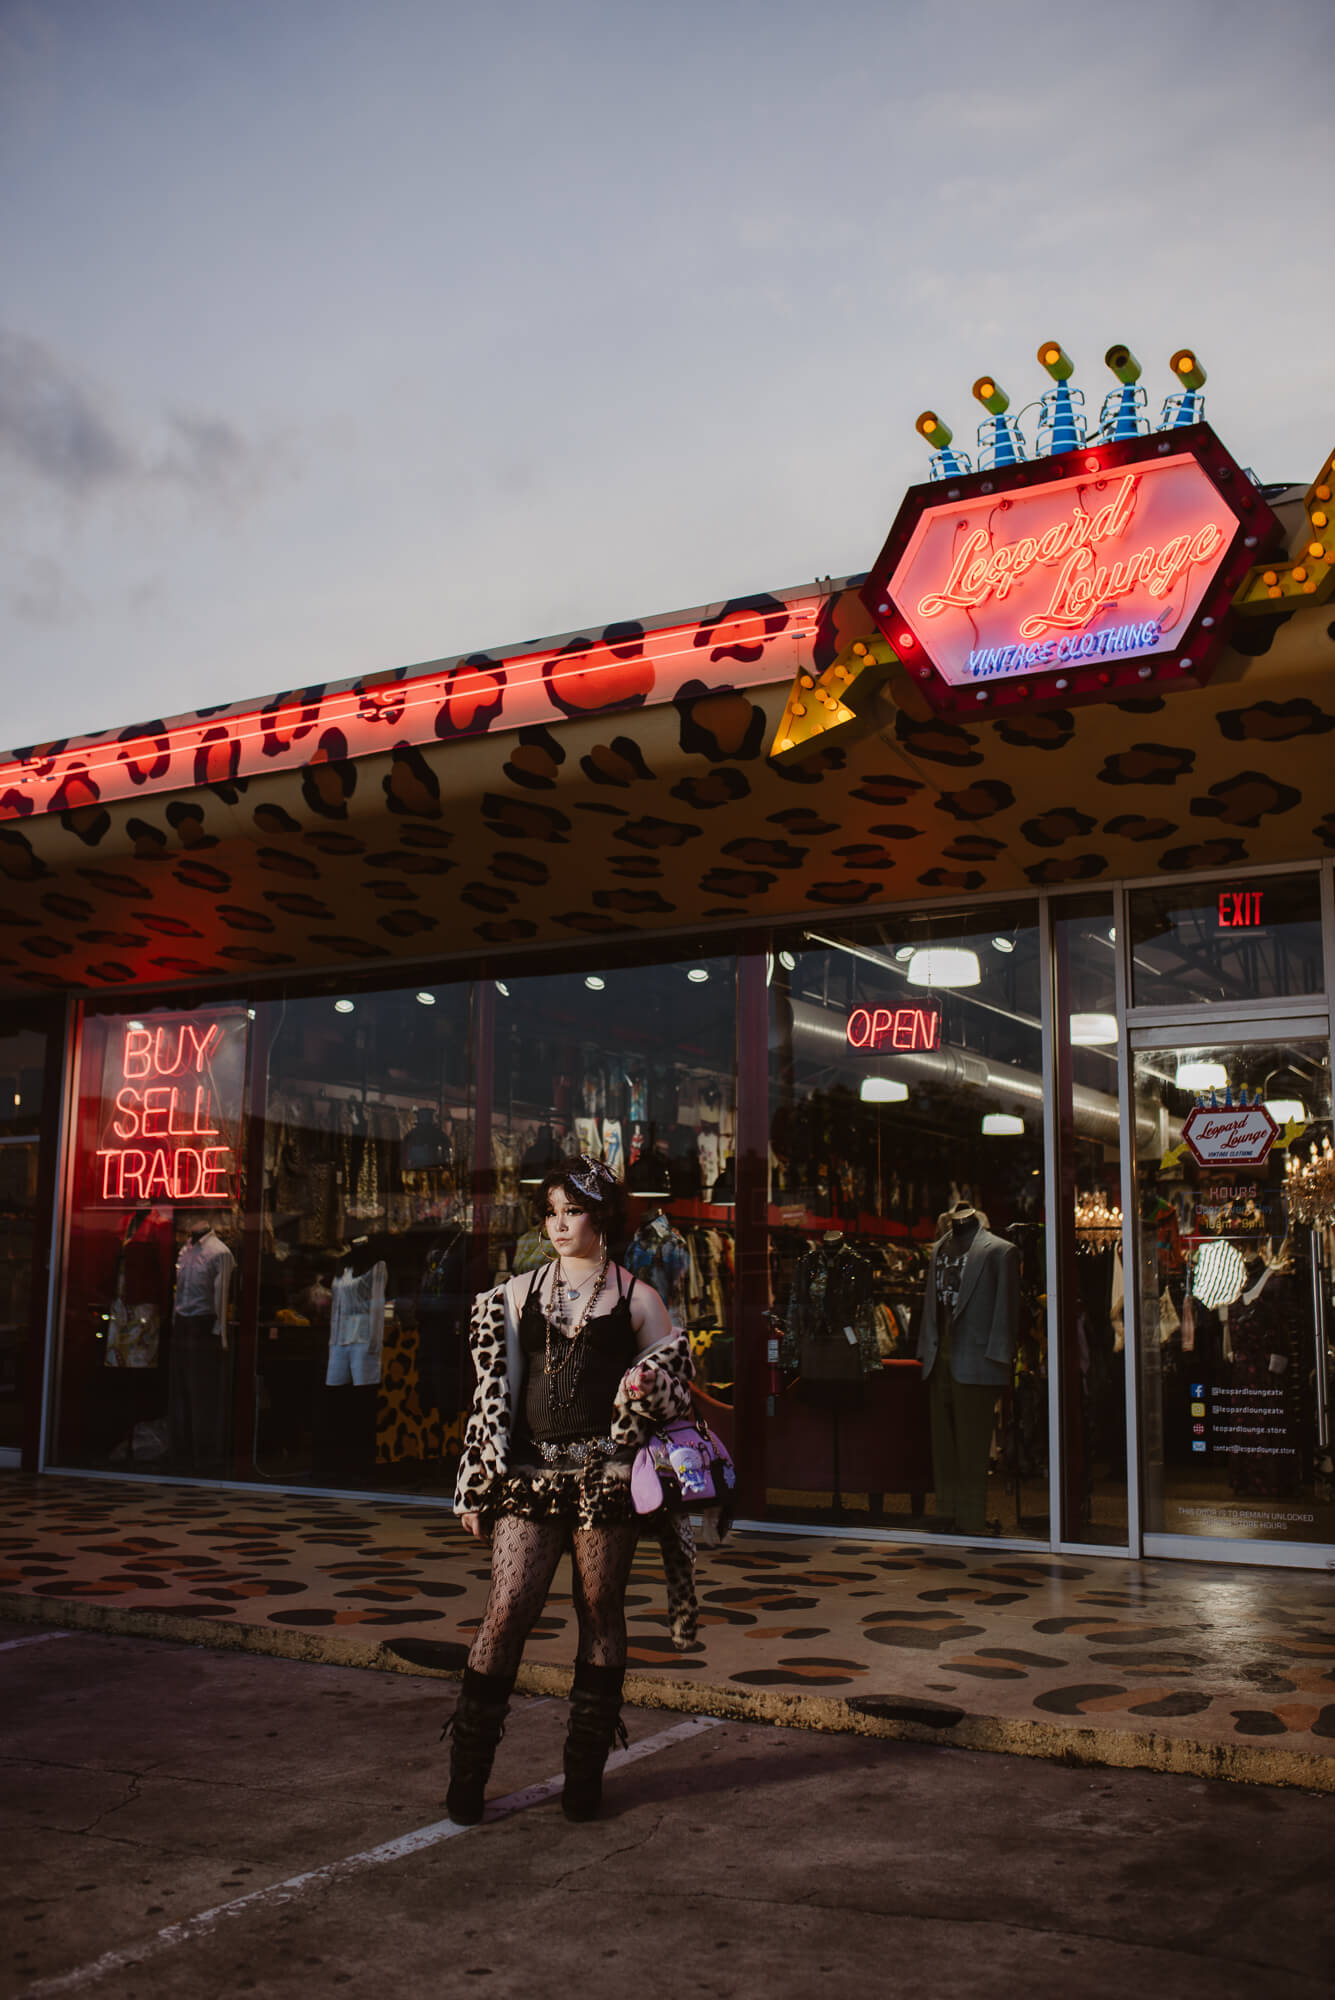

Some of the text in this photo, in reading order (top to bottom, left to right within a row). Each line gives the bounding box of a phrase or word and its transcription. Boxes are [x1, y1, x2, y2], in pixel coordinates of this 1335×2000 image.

[918, 474, 1135, 617] Leopard
[1019, 524, 1218, 638] Lounge
[968, 620, 1157, 671] VINTAGE CLOTHING
[1218, 892, 1264, 927] EXIT
[122, 1023, 218, 1079] BUY
[847, 1008, 938, 1049] OPEN
[113, 1085, 220, 1139] SELL
[1195, 1113, 1250, 1140] Leopard
[1219, 1129, 1268, 1149] Lounge
[96, 1146, 231, 1200] TRADE
[1209, 1185, 1257, 1200] HOURS
[1271, 1512, 1314, 1522] UNLOCKED
